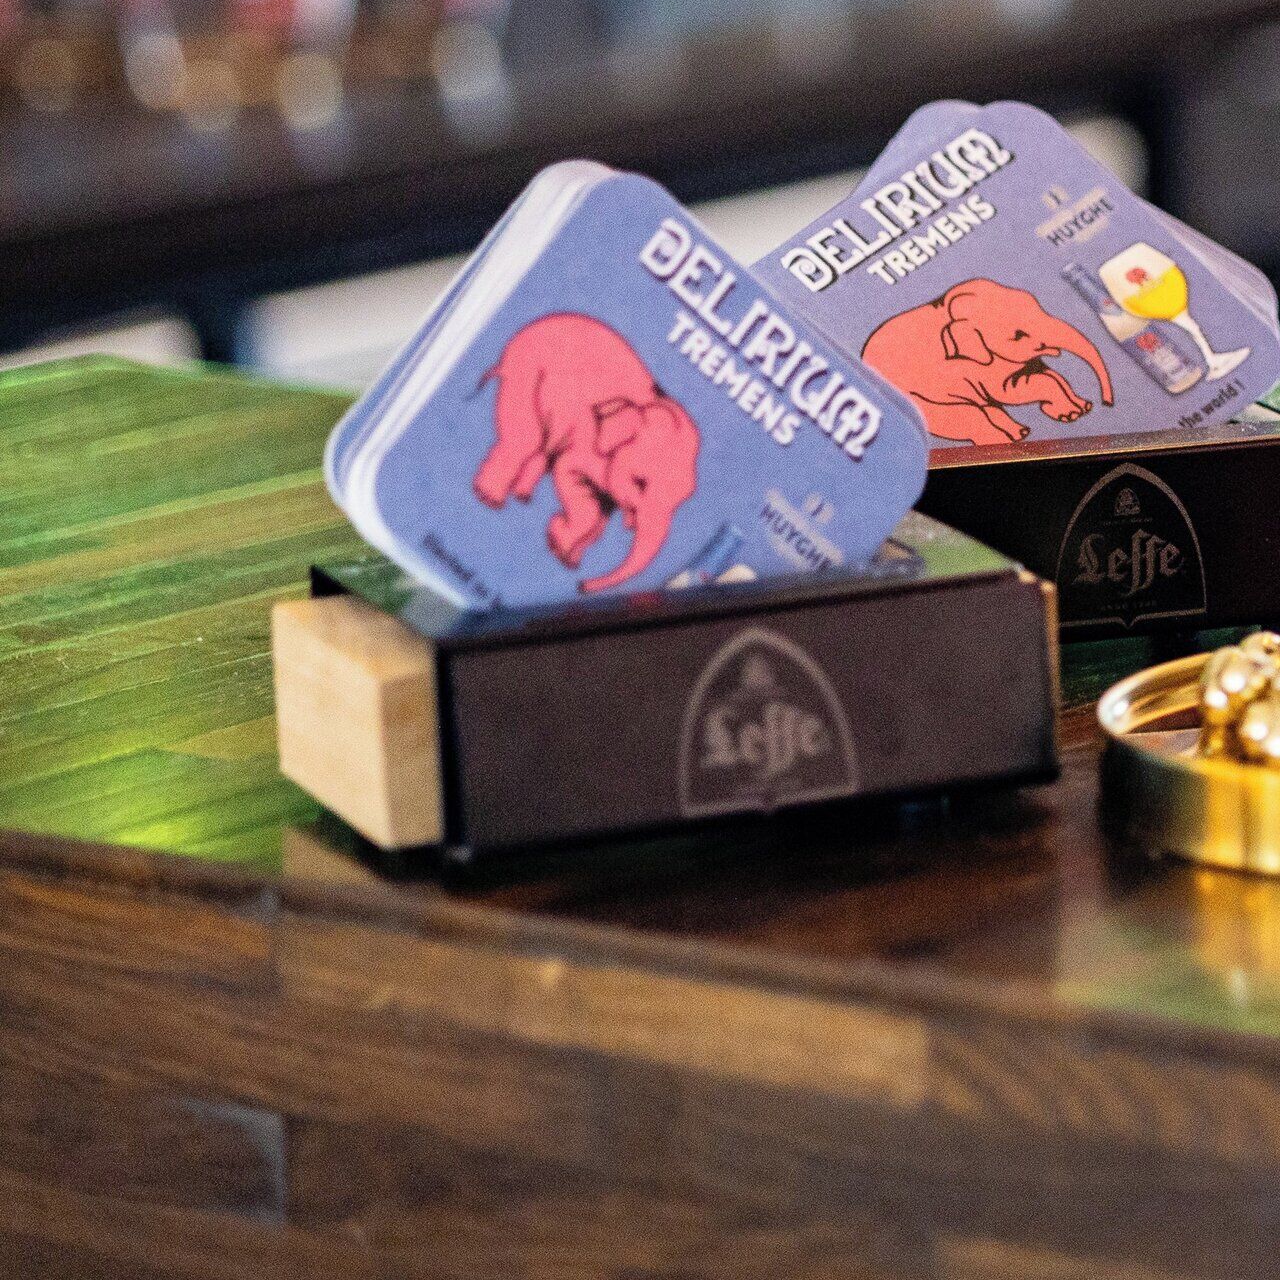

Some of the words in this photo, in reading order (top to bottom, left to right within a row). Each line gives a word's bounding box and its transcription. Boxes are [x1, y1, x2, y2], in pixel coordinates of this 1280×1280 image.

[780, 128, 1015, 292] DELIRIUM
[867, 194, 996, 285] TREMENS
[637, 218, 883, 463] DELIRIUM
[666, 312, 802, 446] TREMENS
[1201, 382, 1239, 416] world
[1071, 528, 1185, 597] Leffe
